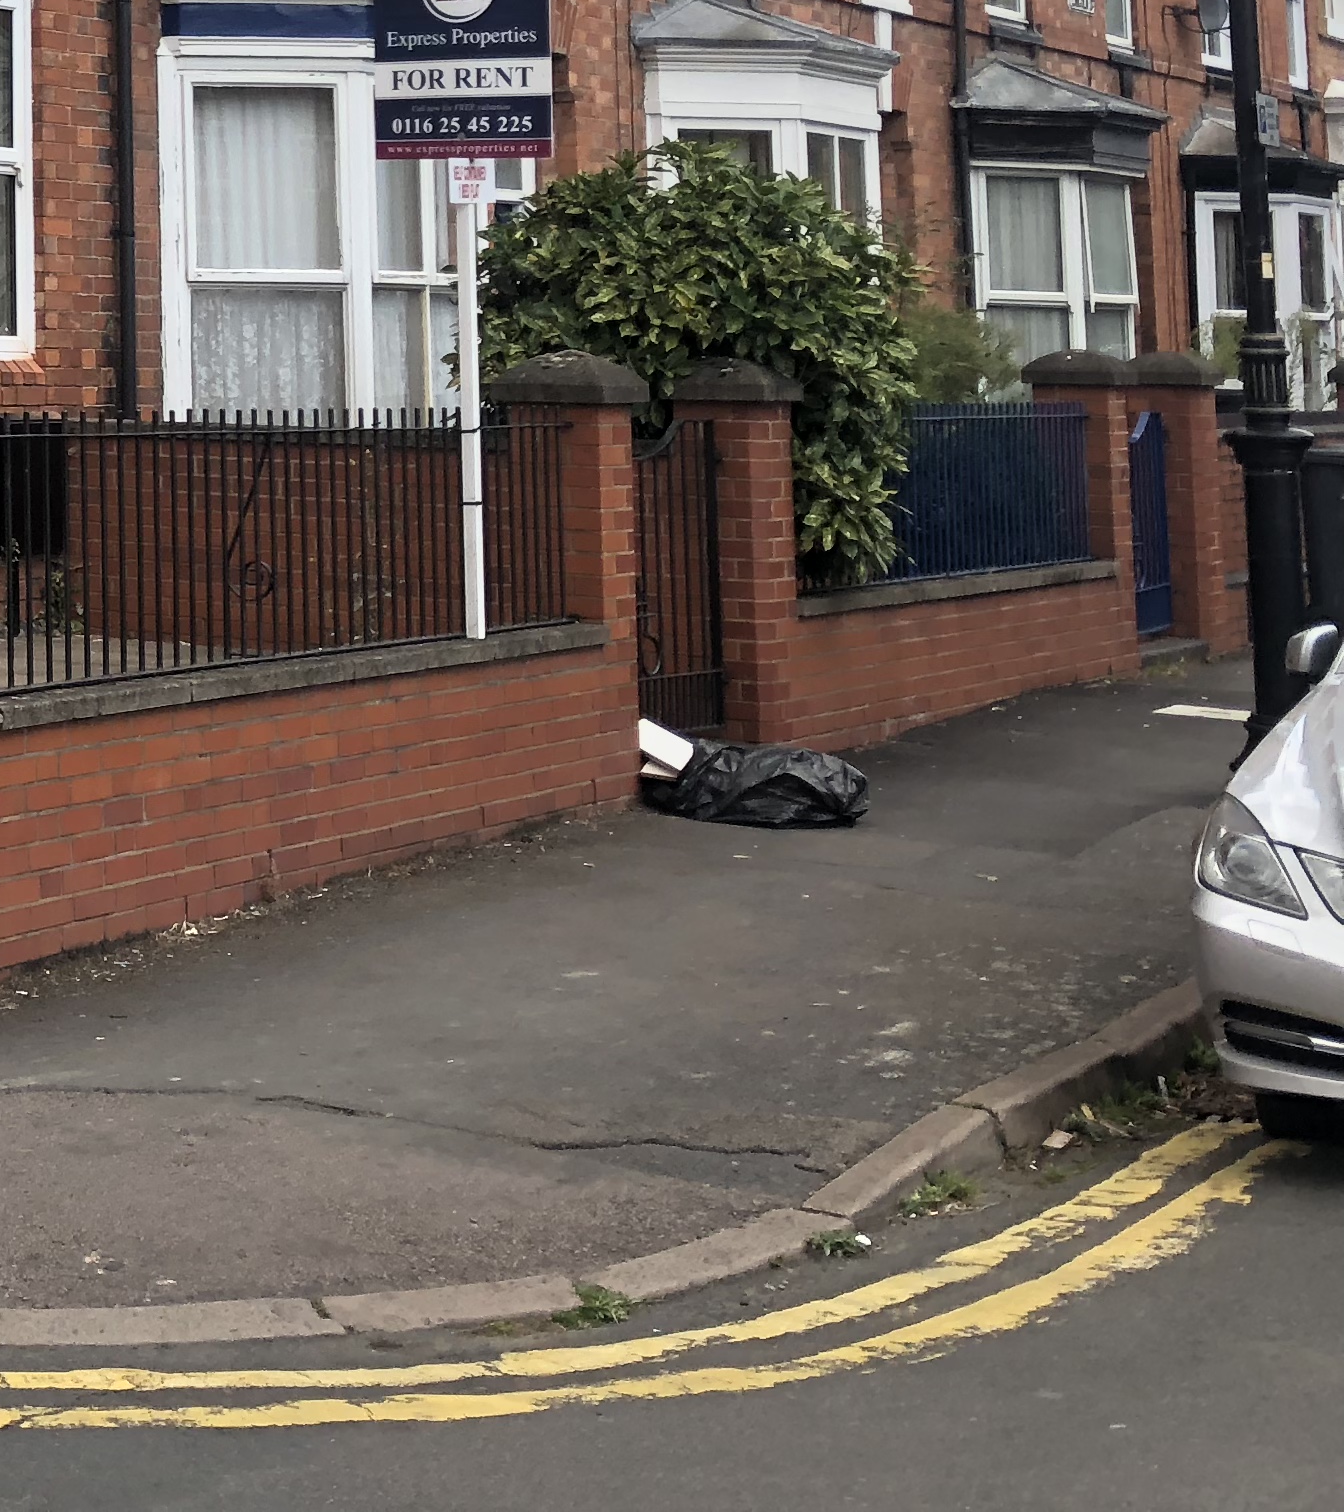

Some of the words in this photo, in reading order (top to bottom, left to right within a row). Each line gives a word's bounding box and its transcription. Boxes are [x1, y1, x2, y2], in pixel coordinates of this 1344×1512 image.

[387, 31, 447, 50] Express
[451, 27, 538, 48] Properties
[391, 68, 446, 91] FOR
[455, 66, 534, 89] RENT
[391, 117, 433, 134] 0116
[439, 116, 461, 133] 25
[467, 116, 490, 133] 45
[497, 115, 533, 133] 225
[387, 144, 538, 155] wwwexpresspropertiesnet
